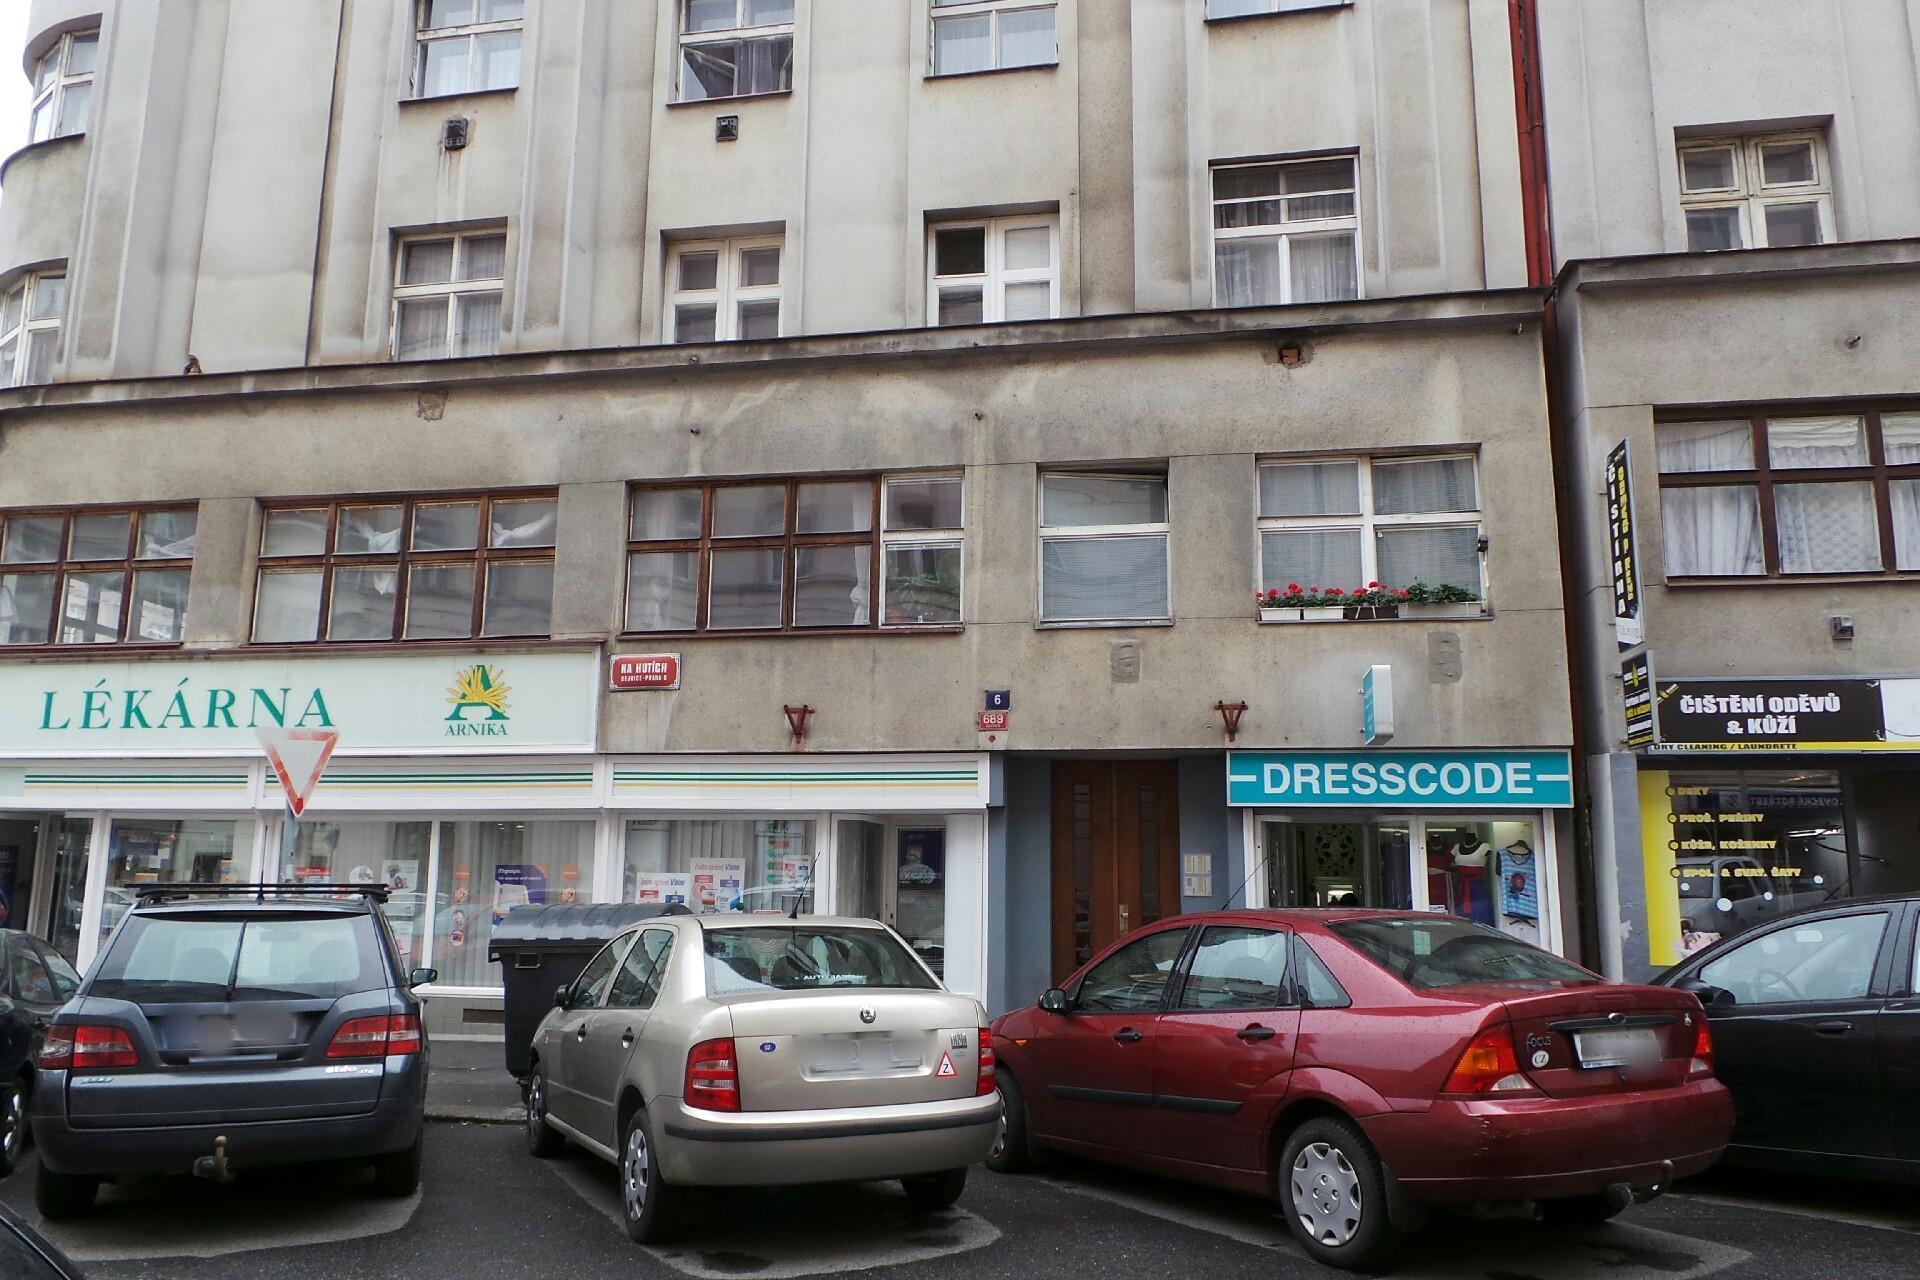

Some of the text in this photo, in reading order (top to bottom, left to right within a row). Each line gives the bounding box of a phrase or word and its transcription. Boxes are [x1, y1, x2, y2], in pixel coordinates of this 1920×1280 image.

[621, 660, 668, 674] NA HUTÍCH
[38, 677, 336, 729] LÉKÁRNA
[994, 694, 1001, 705] 6
[1680, 692, 1841, 713] ČIŠTĚNÍ ODĚVŮ
[983, 714, 1004, 724] 689
[1727, 714, 1797, 734] & KŮŽÍ
[444, 723, 508, 736] ARNIKA
[1263, 762, 1533, 795] DRESSCODE
[1534, 1054, 1547, 1065] CZ
